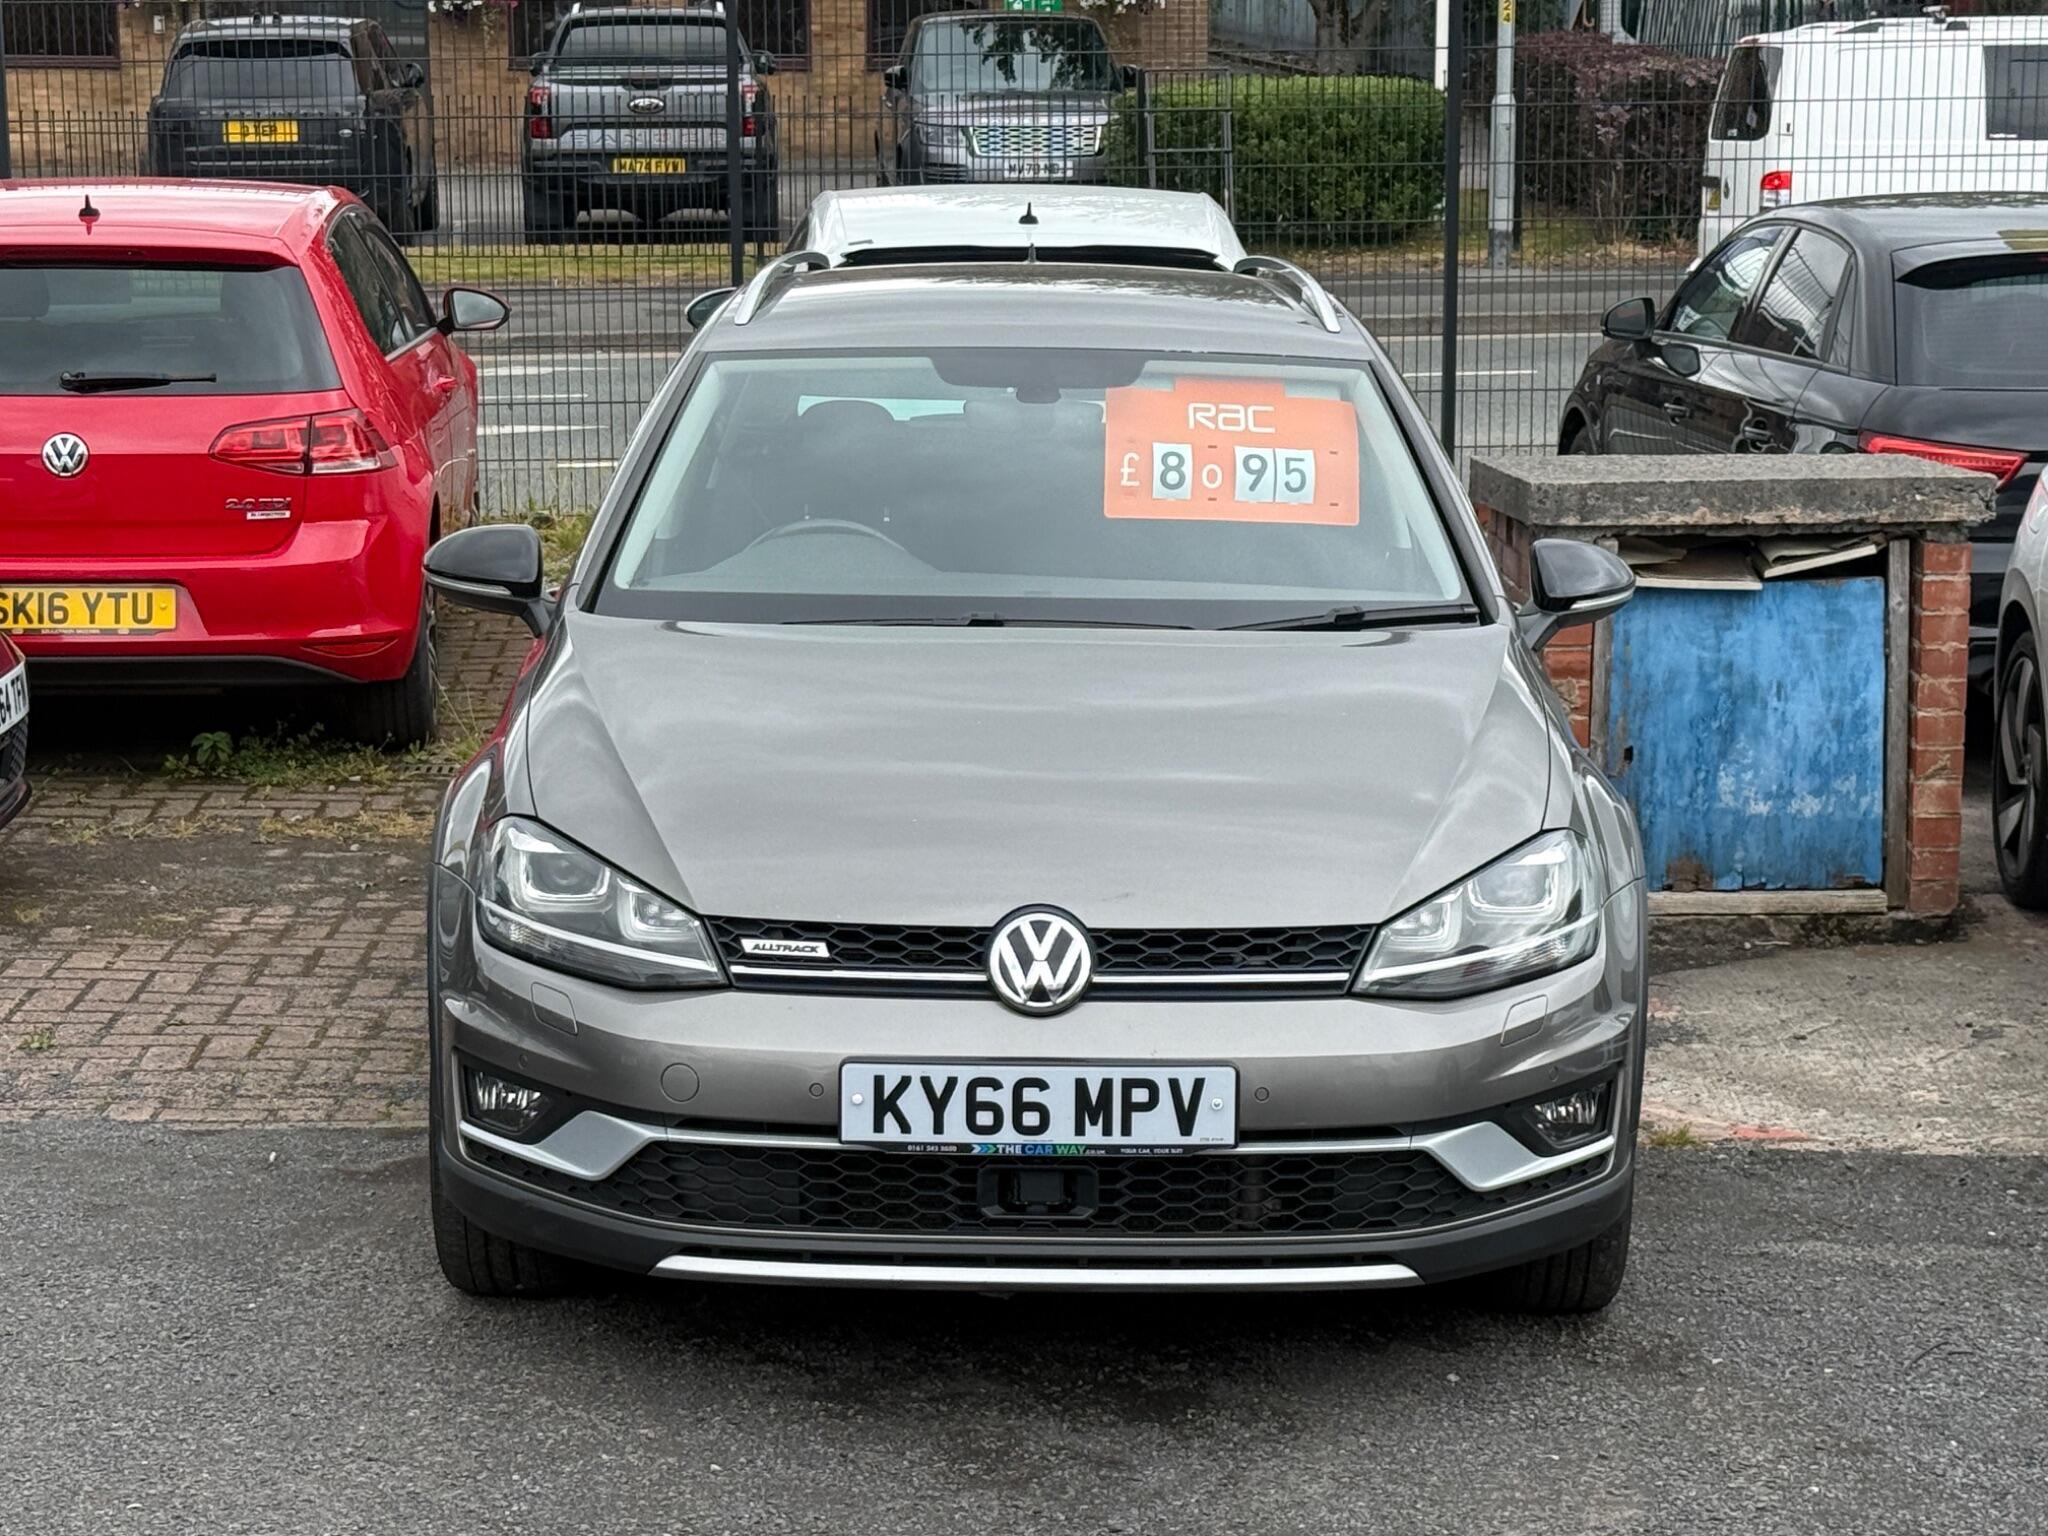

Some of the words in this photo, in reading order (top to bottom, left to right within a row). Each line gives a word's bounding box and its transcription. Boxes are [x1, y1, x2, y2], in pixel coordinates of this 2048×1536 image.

[82, 592, 153, 625] YTU
[751, 943, 821, 954] ALLTRACK
[872, 1074, 1051, 1136] KY66
[1074, 1077, 1206, 1138] MPV
[997, 1144, 1022, 1154] THE
[1025, 1145, 1053, 1154] CAR
[1056, 1145, 1086, 1155] WAY
